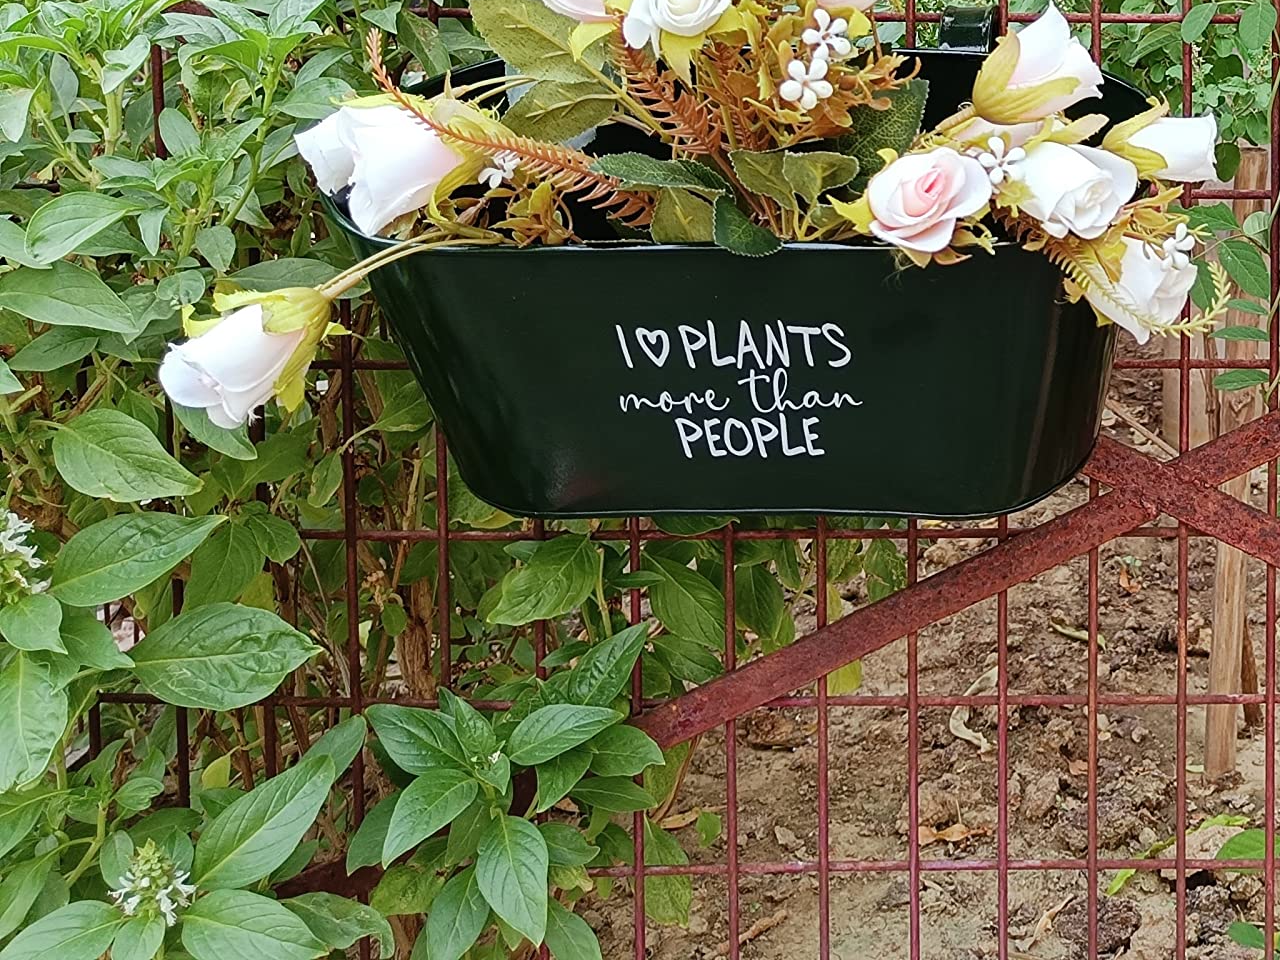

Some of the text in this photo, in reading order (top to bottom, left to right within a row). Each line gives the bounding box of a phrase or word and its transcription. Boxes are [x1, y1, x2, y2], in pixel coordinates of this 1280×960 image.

[615, 319, 851, 370] I PLANTS
[619, 367, 863, 414] more than
[674, 412, 825, 459] PEOPLE
